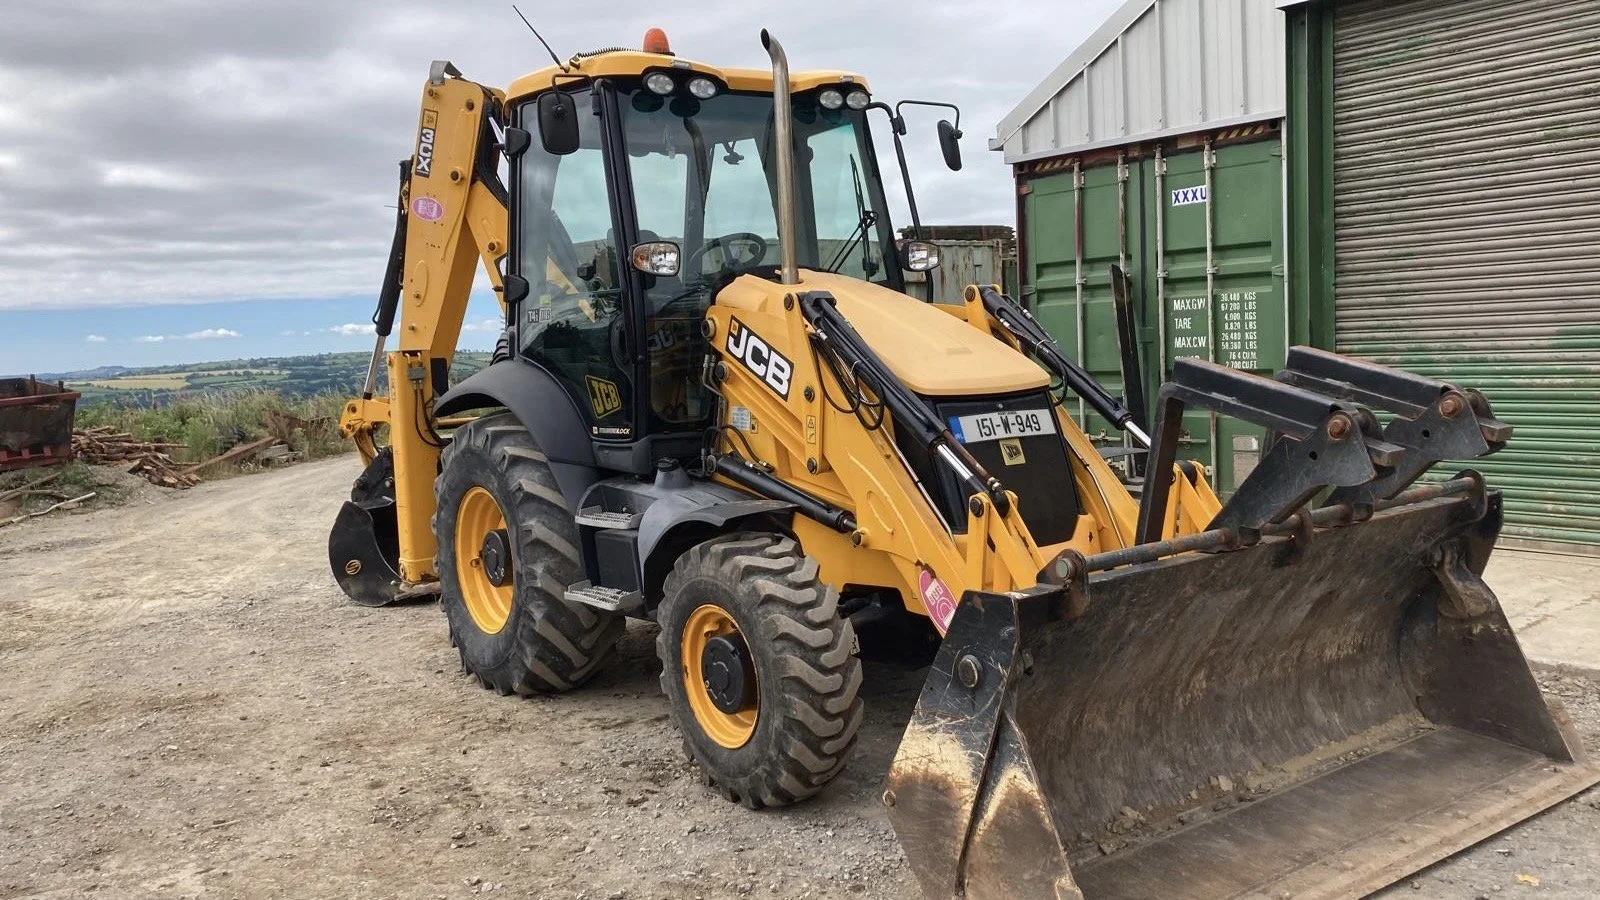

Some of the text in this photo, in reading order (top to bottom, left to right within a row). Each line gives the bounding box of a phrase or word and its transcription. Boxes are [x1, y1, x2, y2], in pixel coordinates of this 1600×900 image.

[416, 128, 434, 172] 3CX
[1173, 187, 1207, 204] XXXU
[1244, 292, 1256, 300] KGS
[1244, 302, 1256, 310] LBS
[1244, 312, 1256, 320] KGS
[1174, 318, 1192, 329] TARE
[1245, 321, 1257, 330] LBS
[1245, 332, 1257, 340] KGS
[1245, 341, 1257, 350] LBS
[728, 327, 791, 395] JCB
[591, 380, 619, 414] JCB
[976, 413, 1041, 438] 151-W-949
